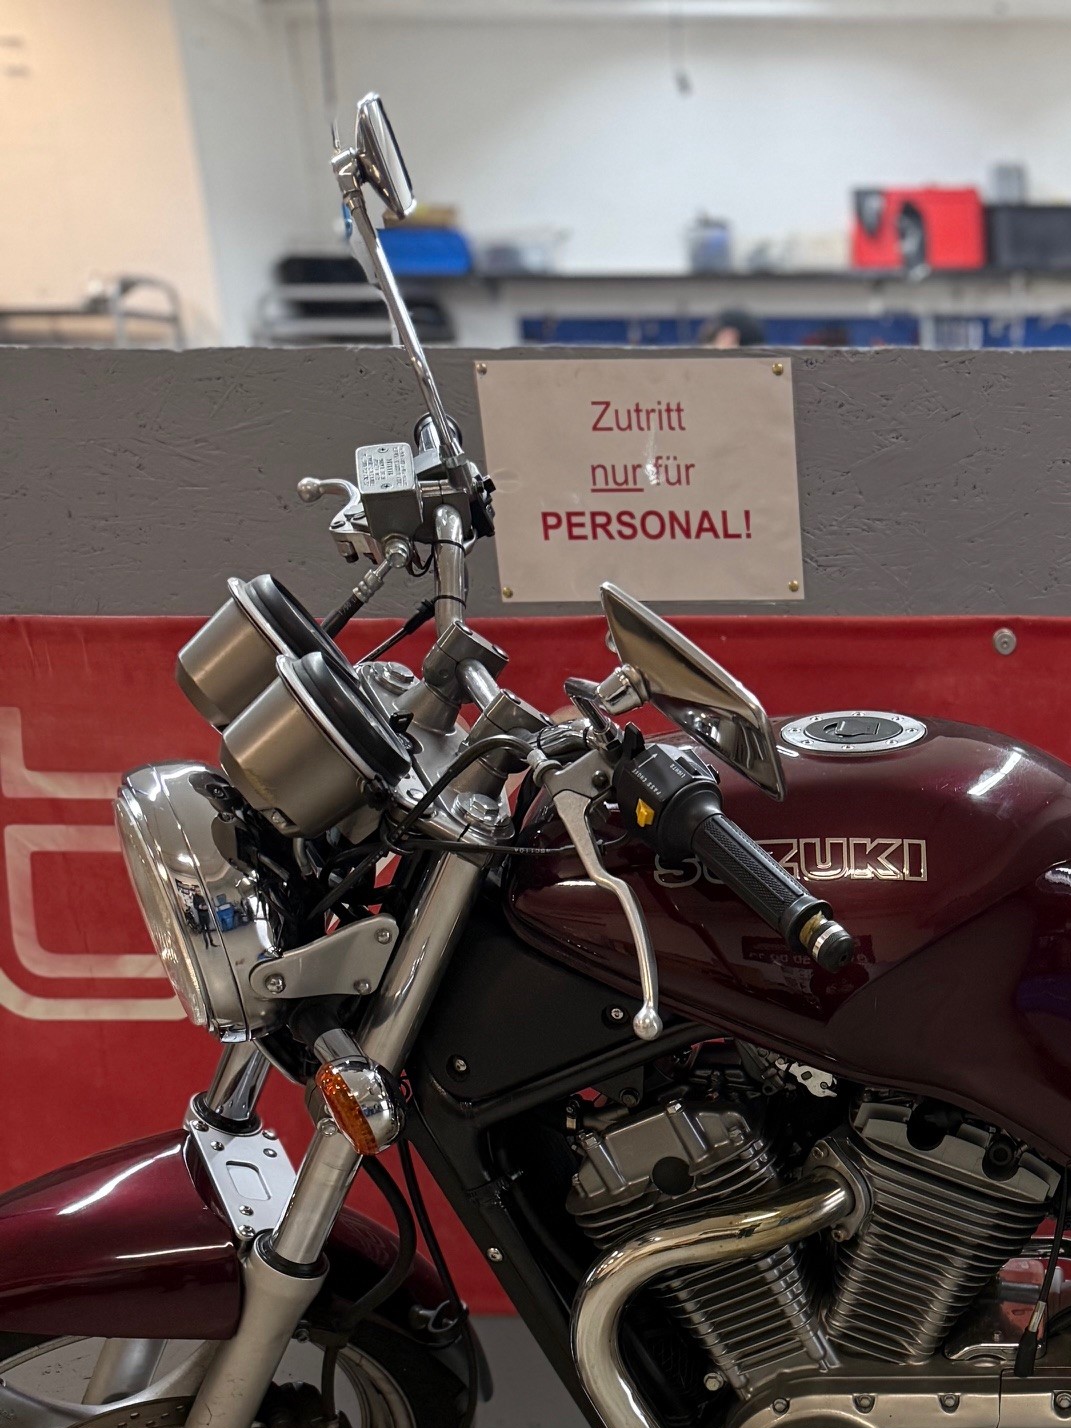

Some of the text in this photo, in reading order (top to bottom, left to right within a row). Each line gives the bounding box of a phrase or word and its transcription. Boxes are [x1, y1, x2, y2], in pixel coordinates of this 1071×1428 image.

[590, 400, 686, 432] Zutritt
[590, 455, 695, 488] nur für
[540, 509, 752, 541] PERSONAL!
[653, 837, 928, 889] SZUKI
